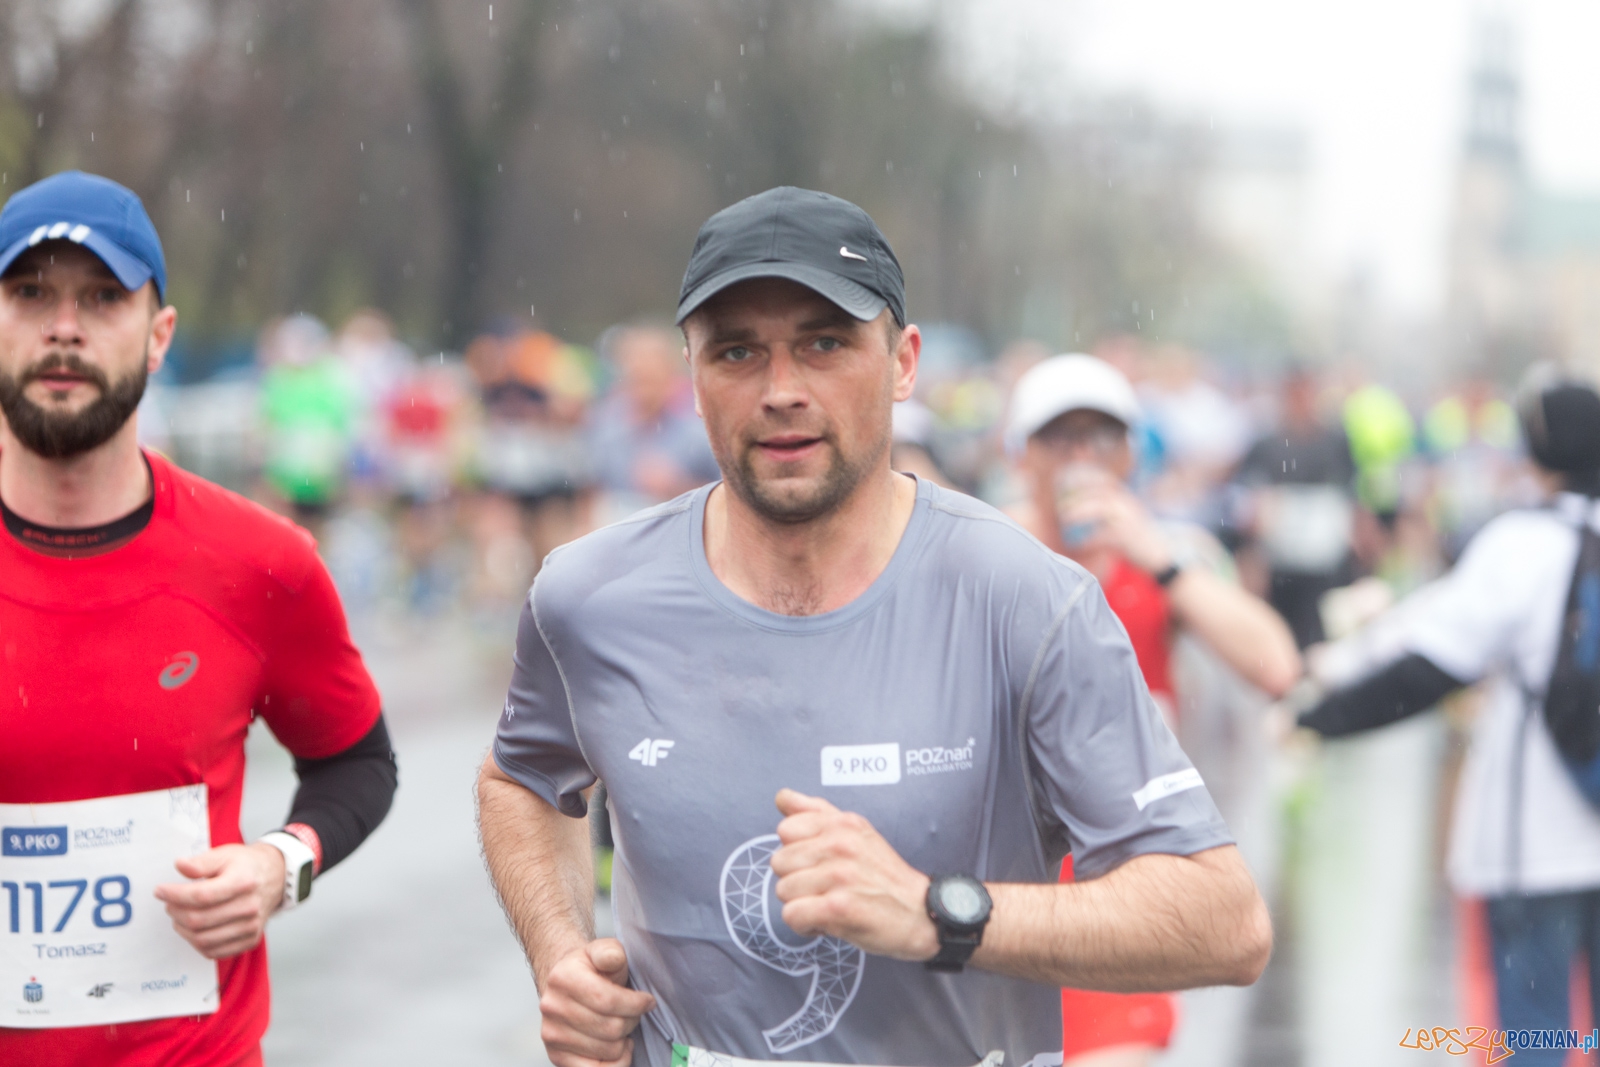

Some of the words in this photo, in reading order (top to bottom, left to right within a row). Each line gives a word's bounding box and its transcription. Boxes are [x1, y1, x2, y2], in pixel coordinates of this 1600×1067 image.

[628, 738, 675, 767] 4F
[0, 875, 133, 934] 1178
[32, 942, 108, 960] Tomasz
[719, 833, 866, 1054] 9
